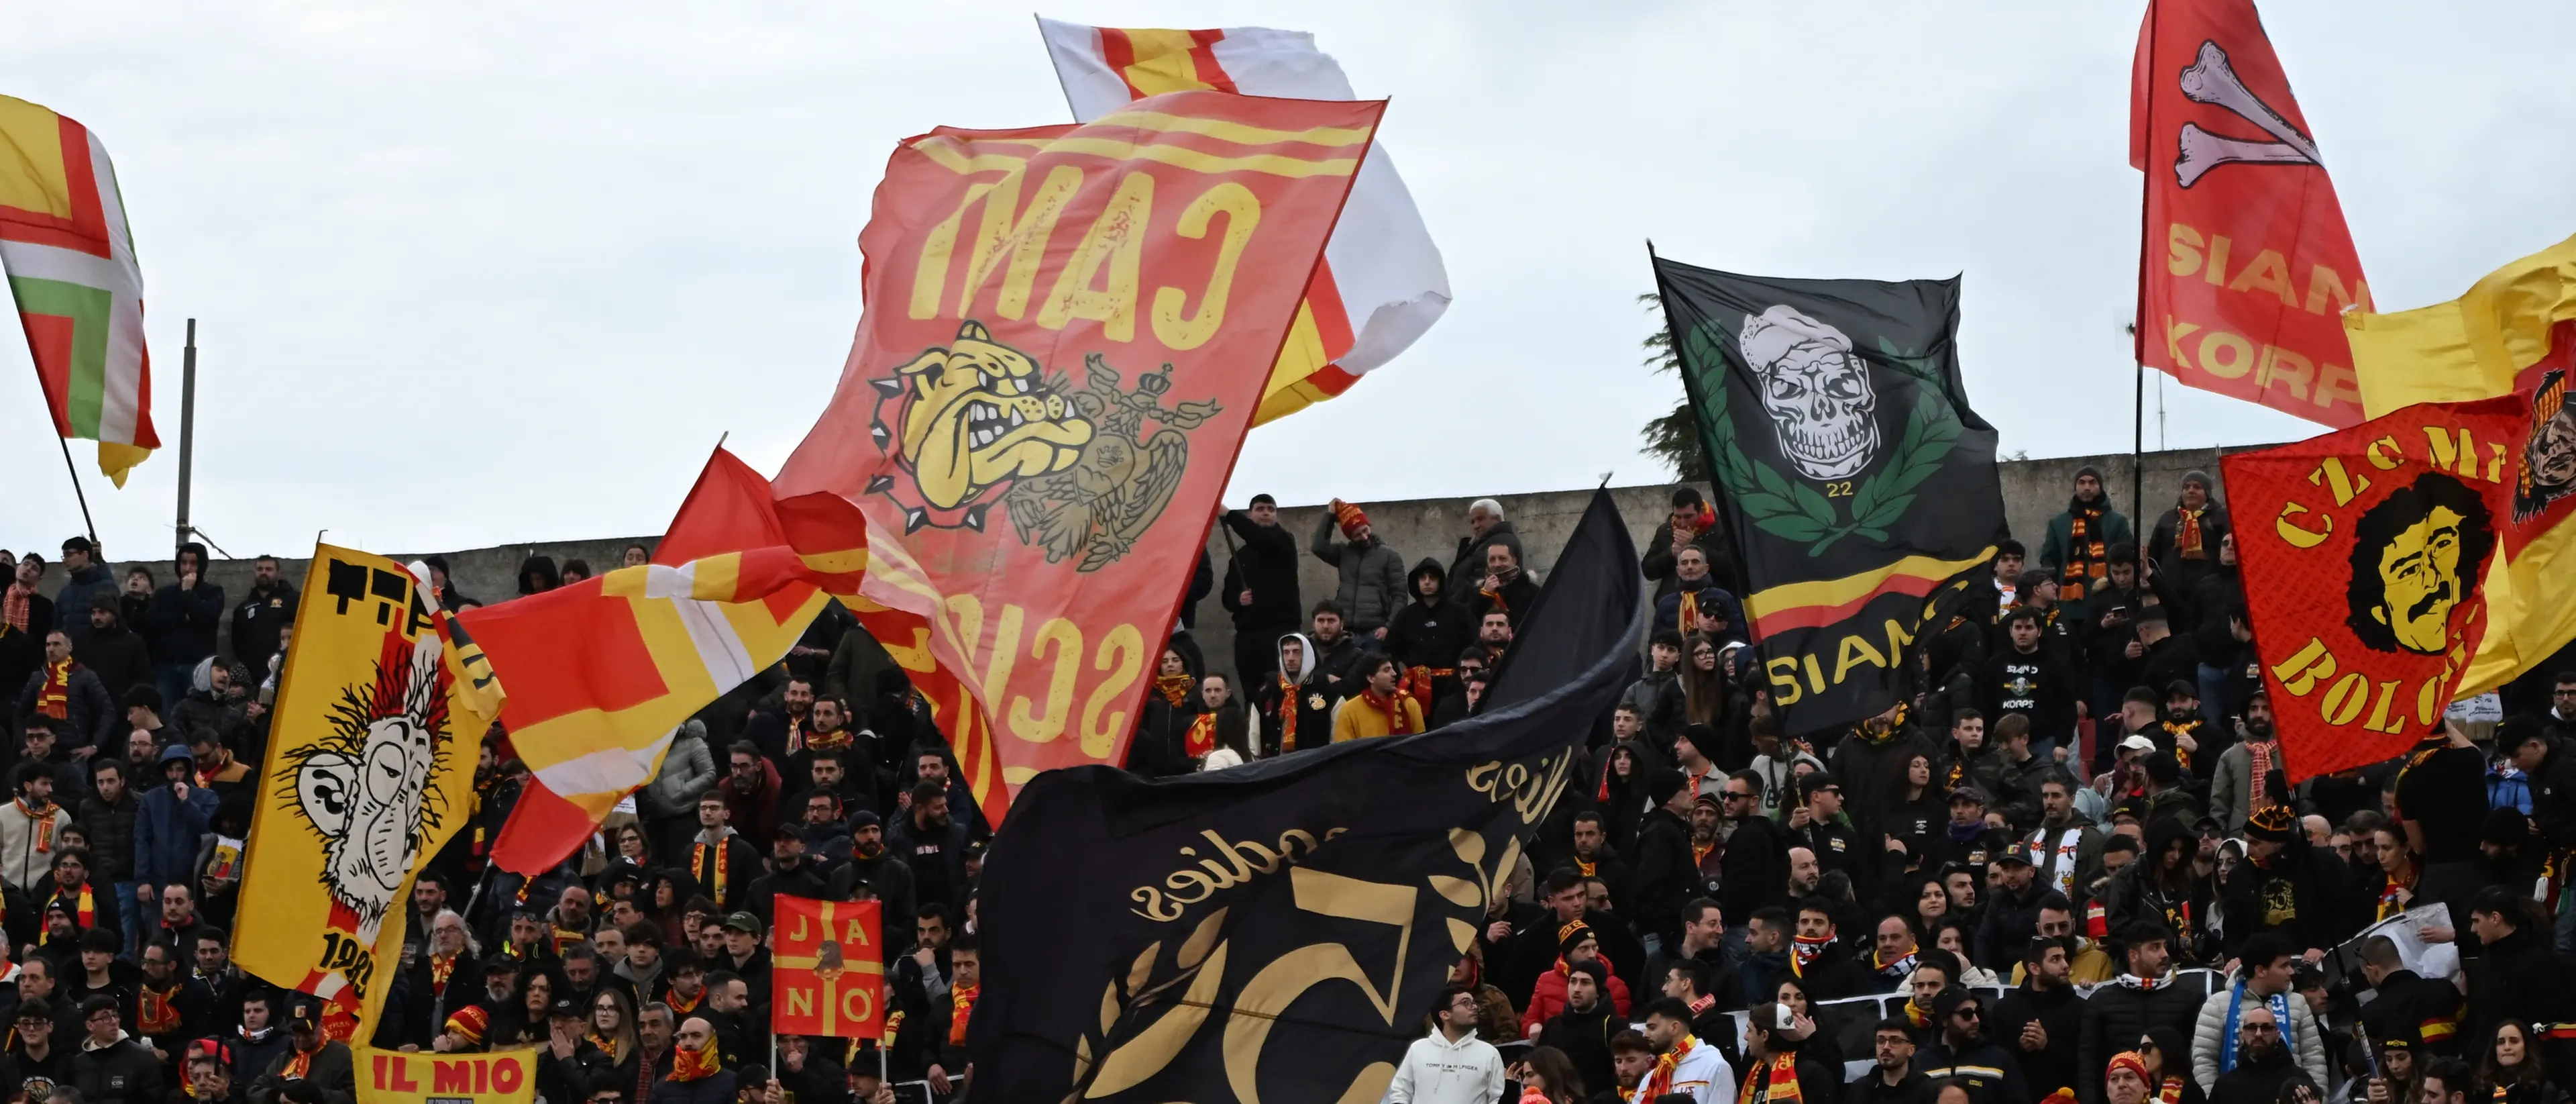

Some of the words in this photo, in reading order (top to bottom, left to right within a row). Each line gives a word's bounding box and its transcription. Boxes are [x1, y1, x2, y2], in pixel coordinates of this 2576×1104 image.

[1827, 481, 1854, 498] 22
[2002, 699, 2035, 709] KORPS
[373, 1056, 418, 1093] IL
[432, 1058, 523, 1095] MIO
